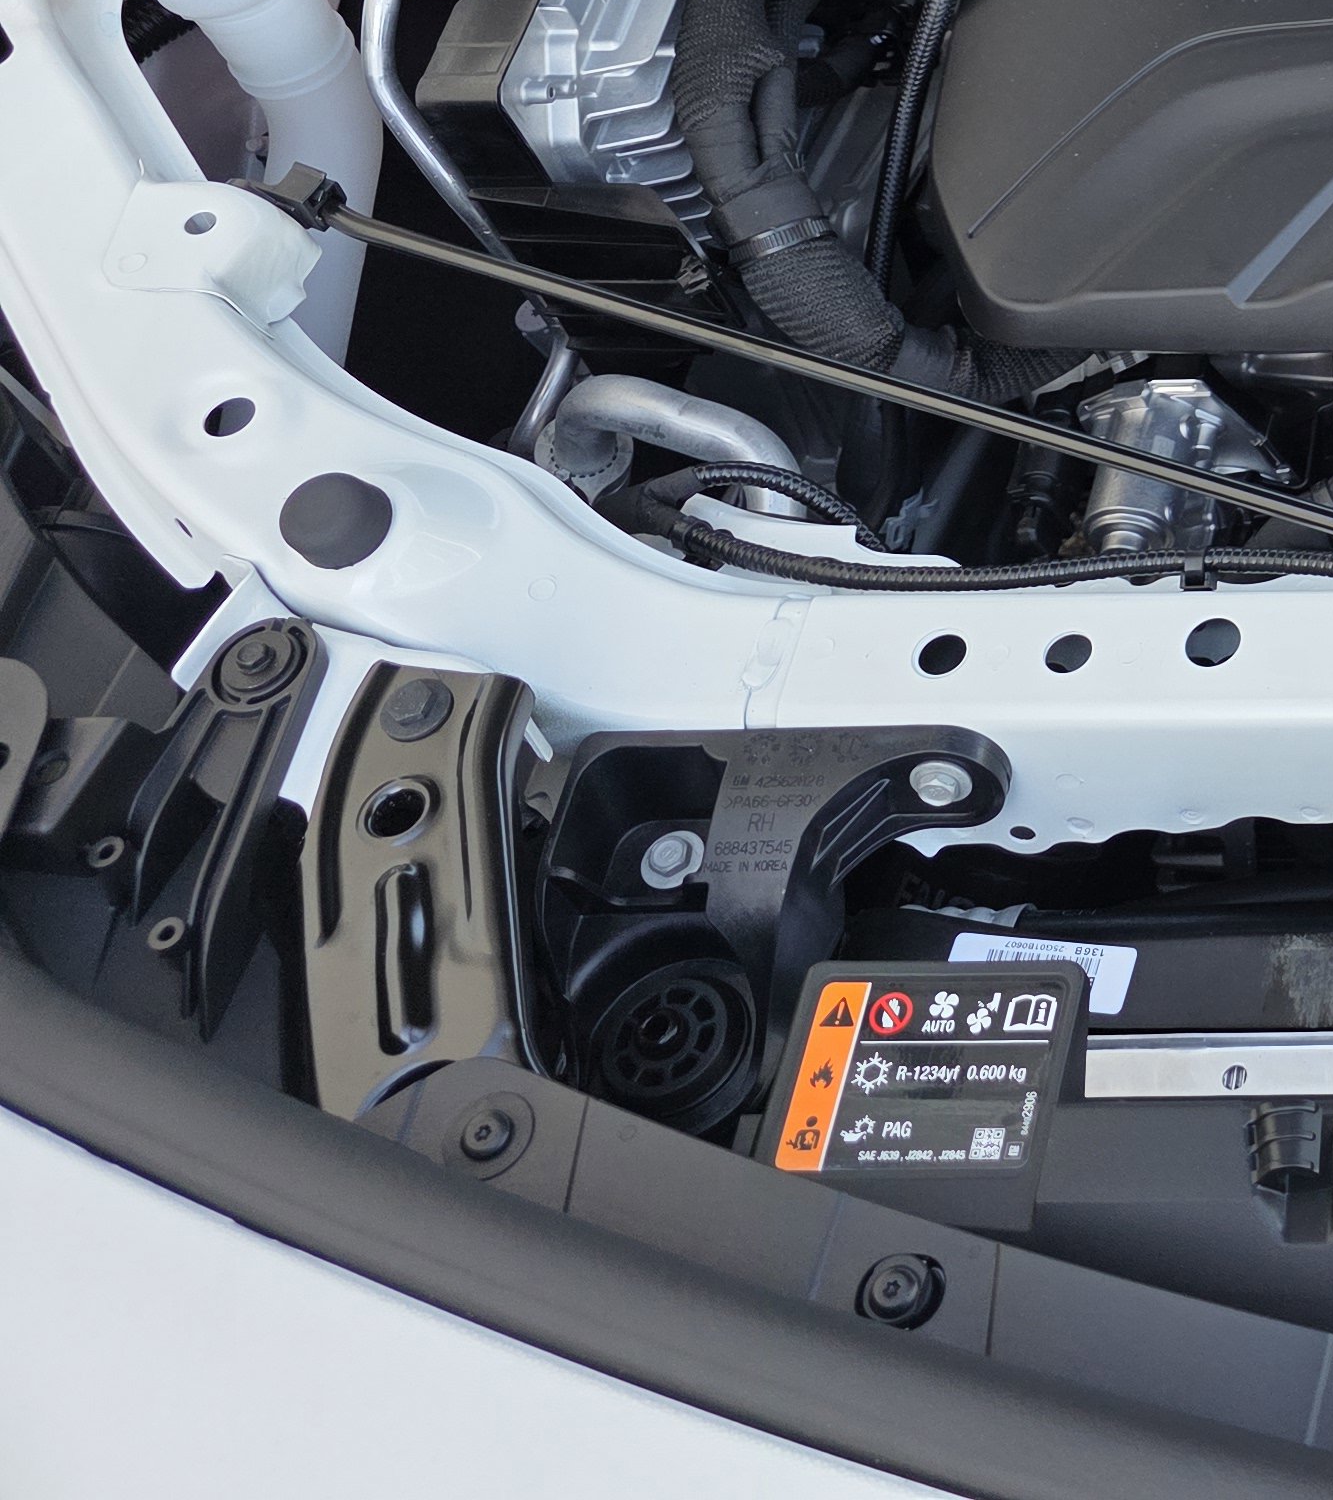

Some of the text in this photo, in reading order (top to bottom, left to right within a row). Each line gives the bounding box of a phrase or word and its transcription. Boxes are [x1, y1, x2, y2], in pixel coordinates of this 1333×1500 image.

[747, 812, 776, 832] RH
[714, 839, 794, 857] 688437545
[702, 859, 789, 874] MADE IN KOREA
[921, 1019, 956, 1034] AUTO
[895, 1064, 1028, 1084] R-1234yf 0.600 kg
[881, 1120, 913, 1139] PAG
[857, 1150, 877, 1161] SAE
[938, 1150, 966, 1161] J2845
